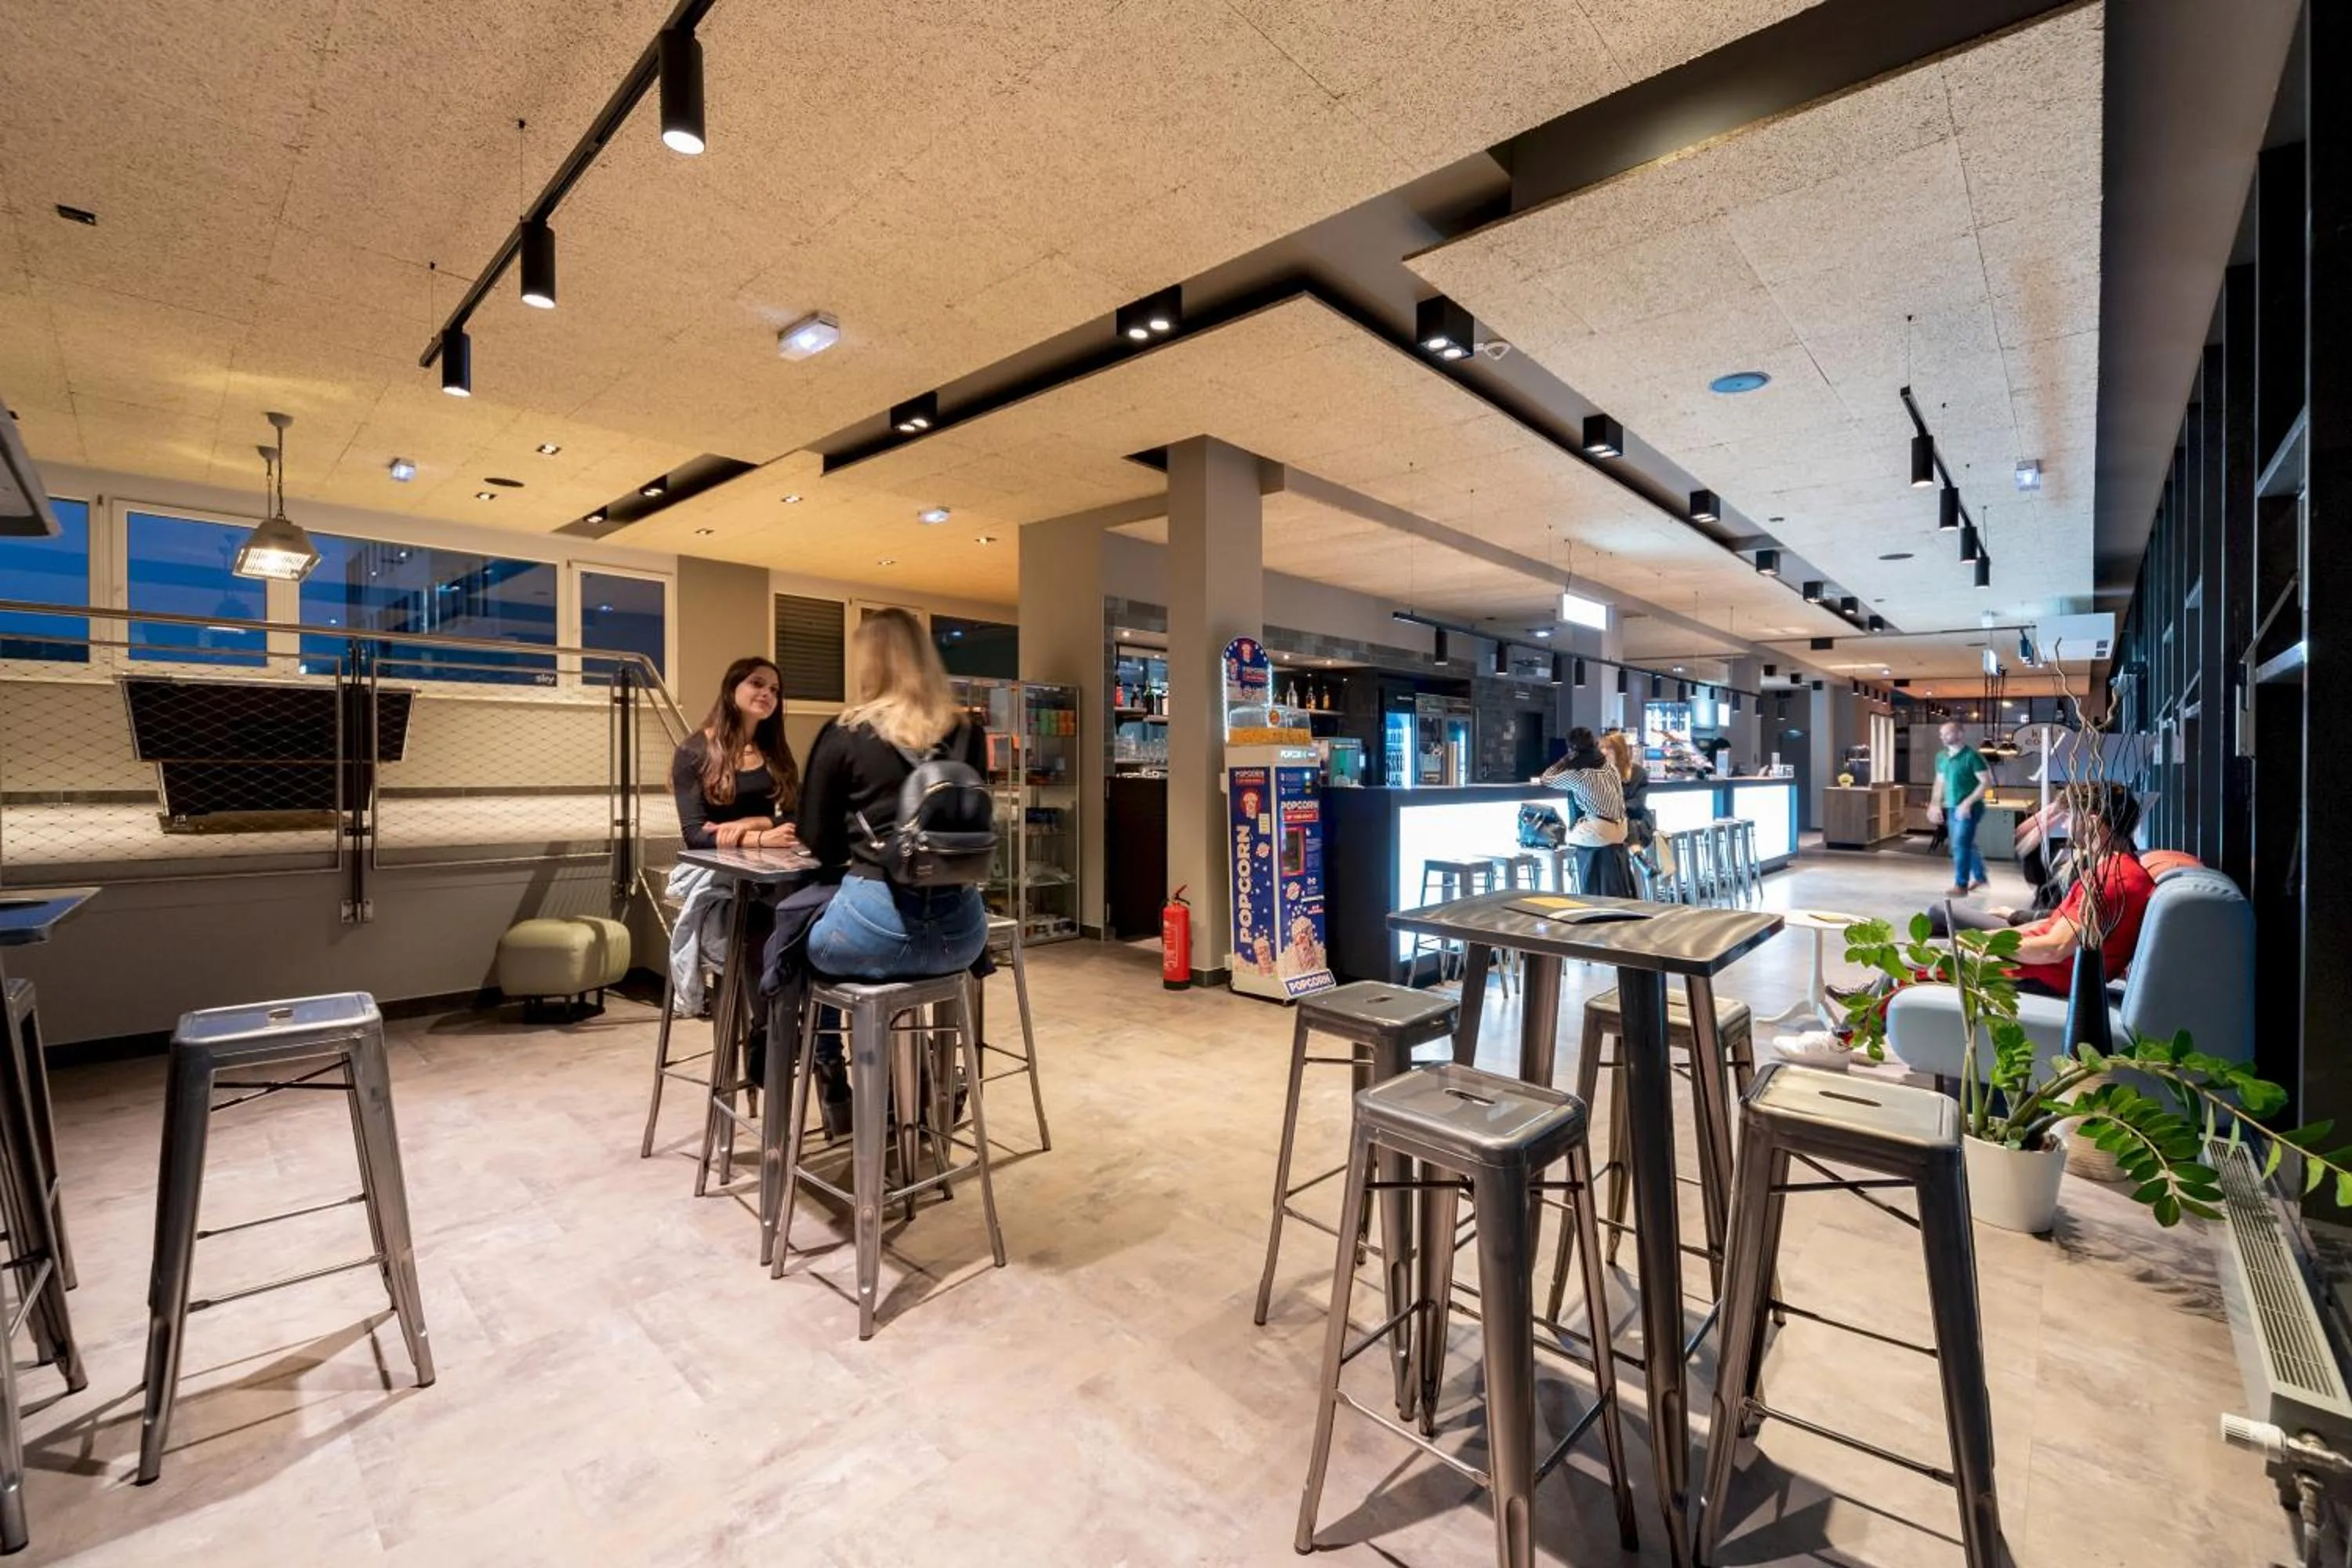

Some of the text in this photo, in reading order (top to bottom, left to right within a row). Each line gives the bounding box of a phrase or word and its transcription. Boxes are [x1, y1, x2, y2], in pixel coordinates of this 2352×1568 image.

[1280, 800, 1319, 810] POPCORN
[1236, 825, 1253, 943] POPCORN
[1288, 973, 1331, 993] POPCORN
